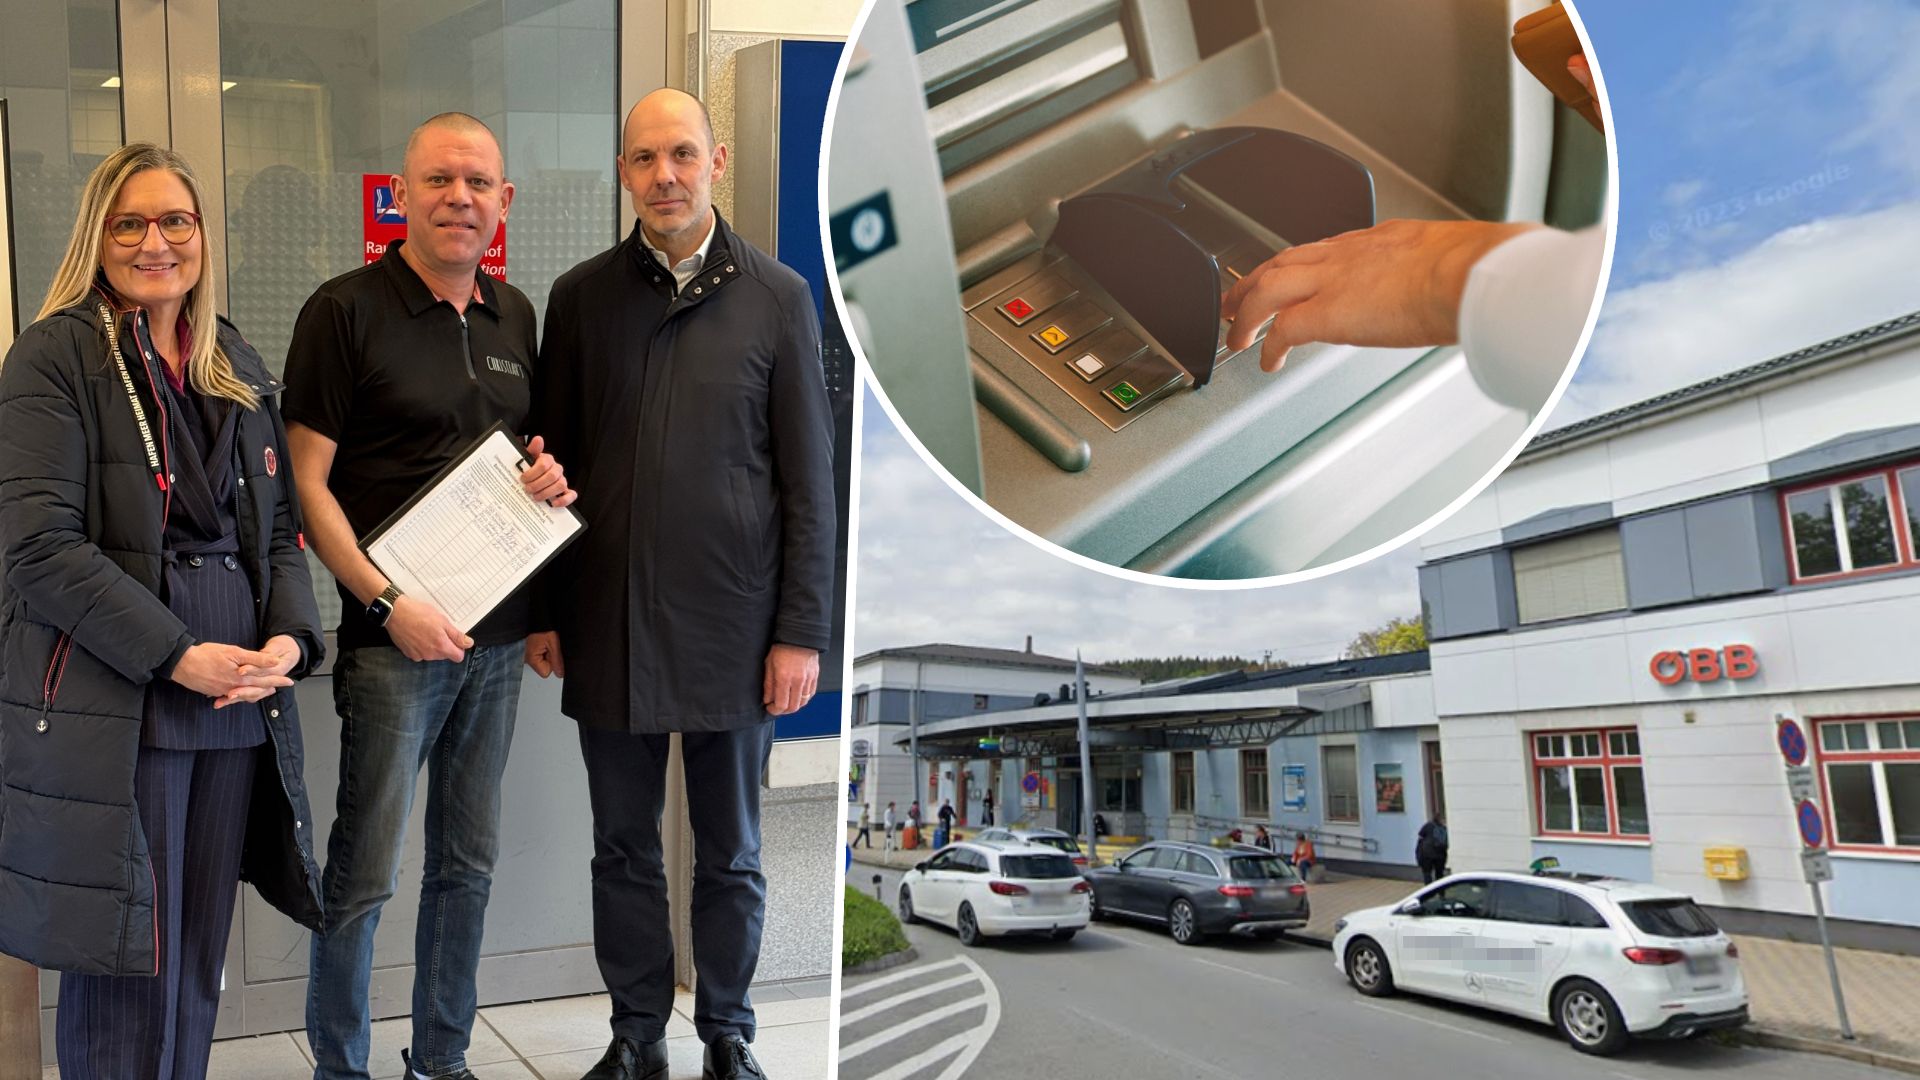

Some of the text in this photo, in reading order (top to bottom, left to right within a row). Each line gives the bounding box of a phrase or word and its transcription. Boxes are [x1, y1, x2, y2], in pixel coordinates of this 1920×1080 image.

[481, 262, 506, 276] tion
[113, 350, 127, 371] MEER
[120, 370, 136, 394] HAFEN
[128, 394, 146, 421] HEIMAT
[138, 420, 153, 442] MEER
[145, 441, 160, 467] HAFEN
